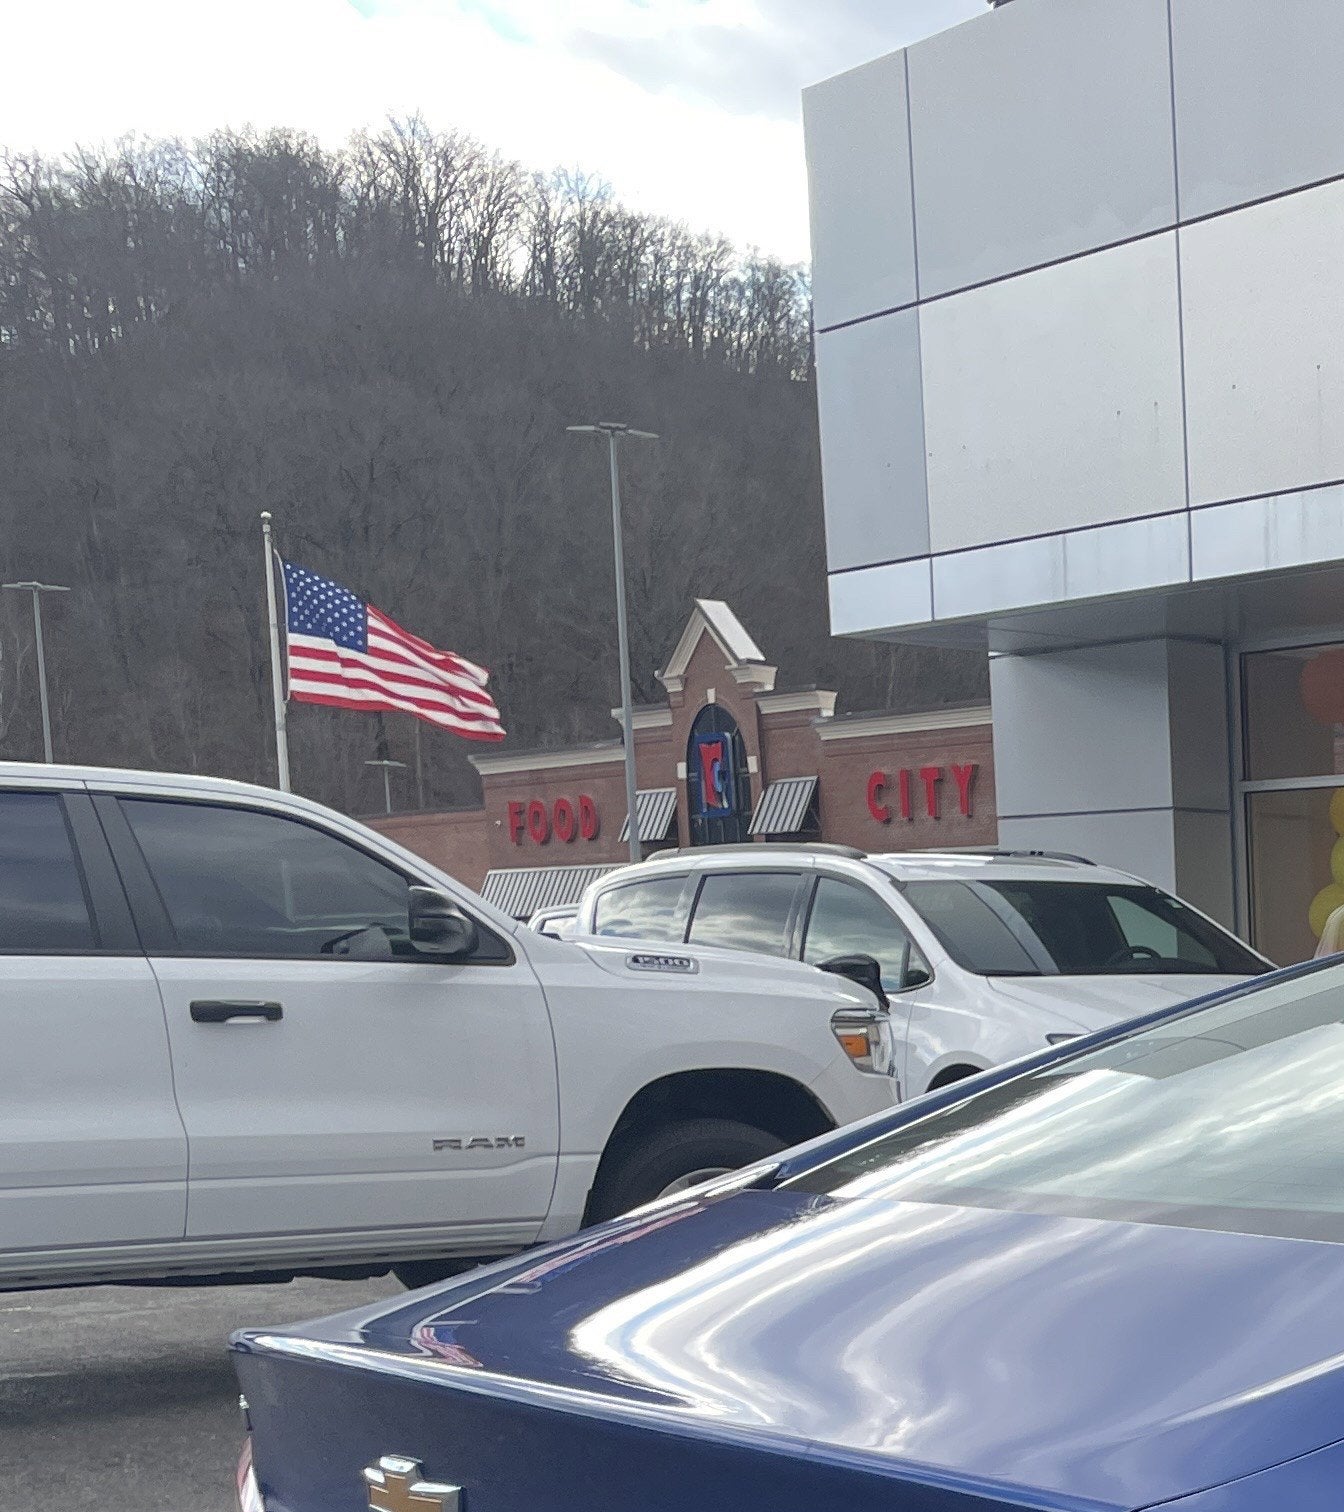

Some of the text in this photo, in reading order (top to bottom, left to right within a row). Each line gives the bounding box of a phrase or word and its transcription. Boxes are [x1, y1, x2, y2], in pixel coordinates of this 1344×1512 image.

[866, 763, 977, 823] CITY
[507, 794, 598, 845] FOOD
[432, 1136, 525, 1151] RAM
